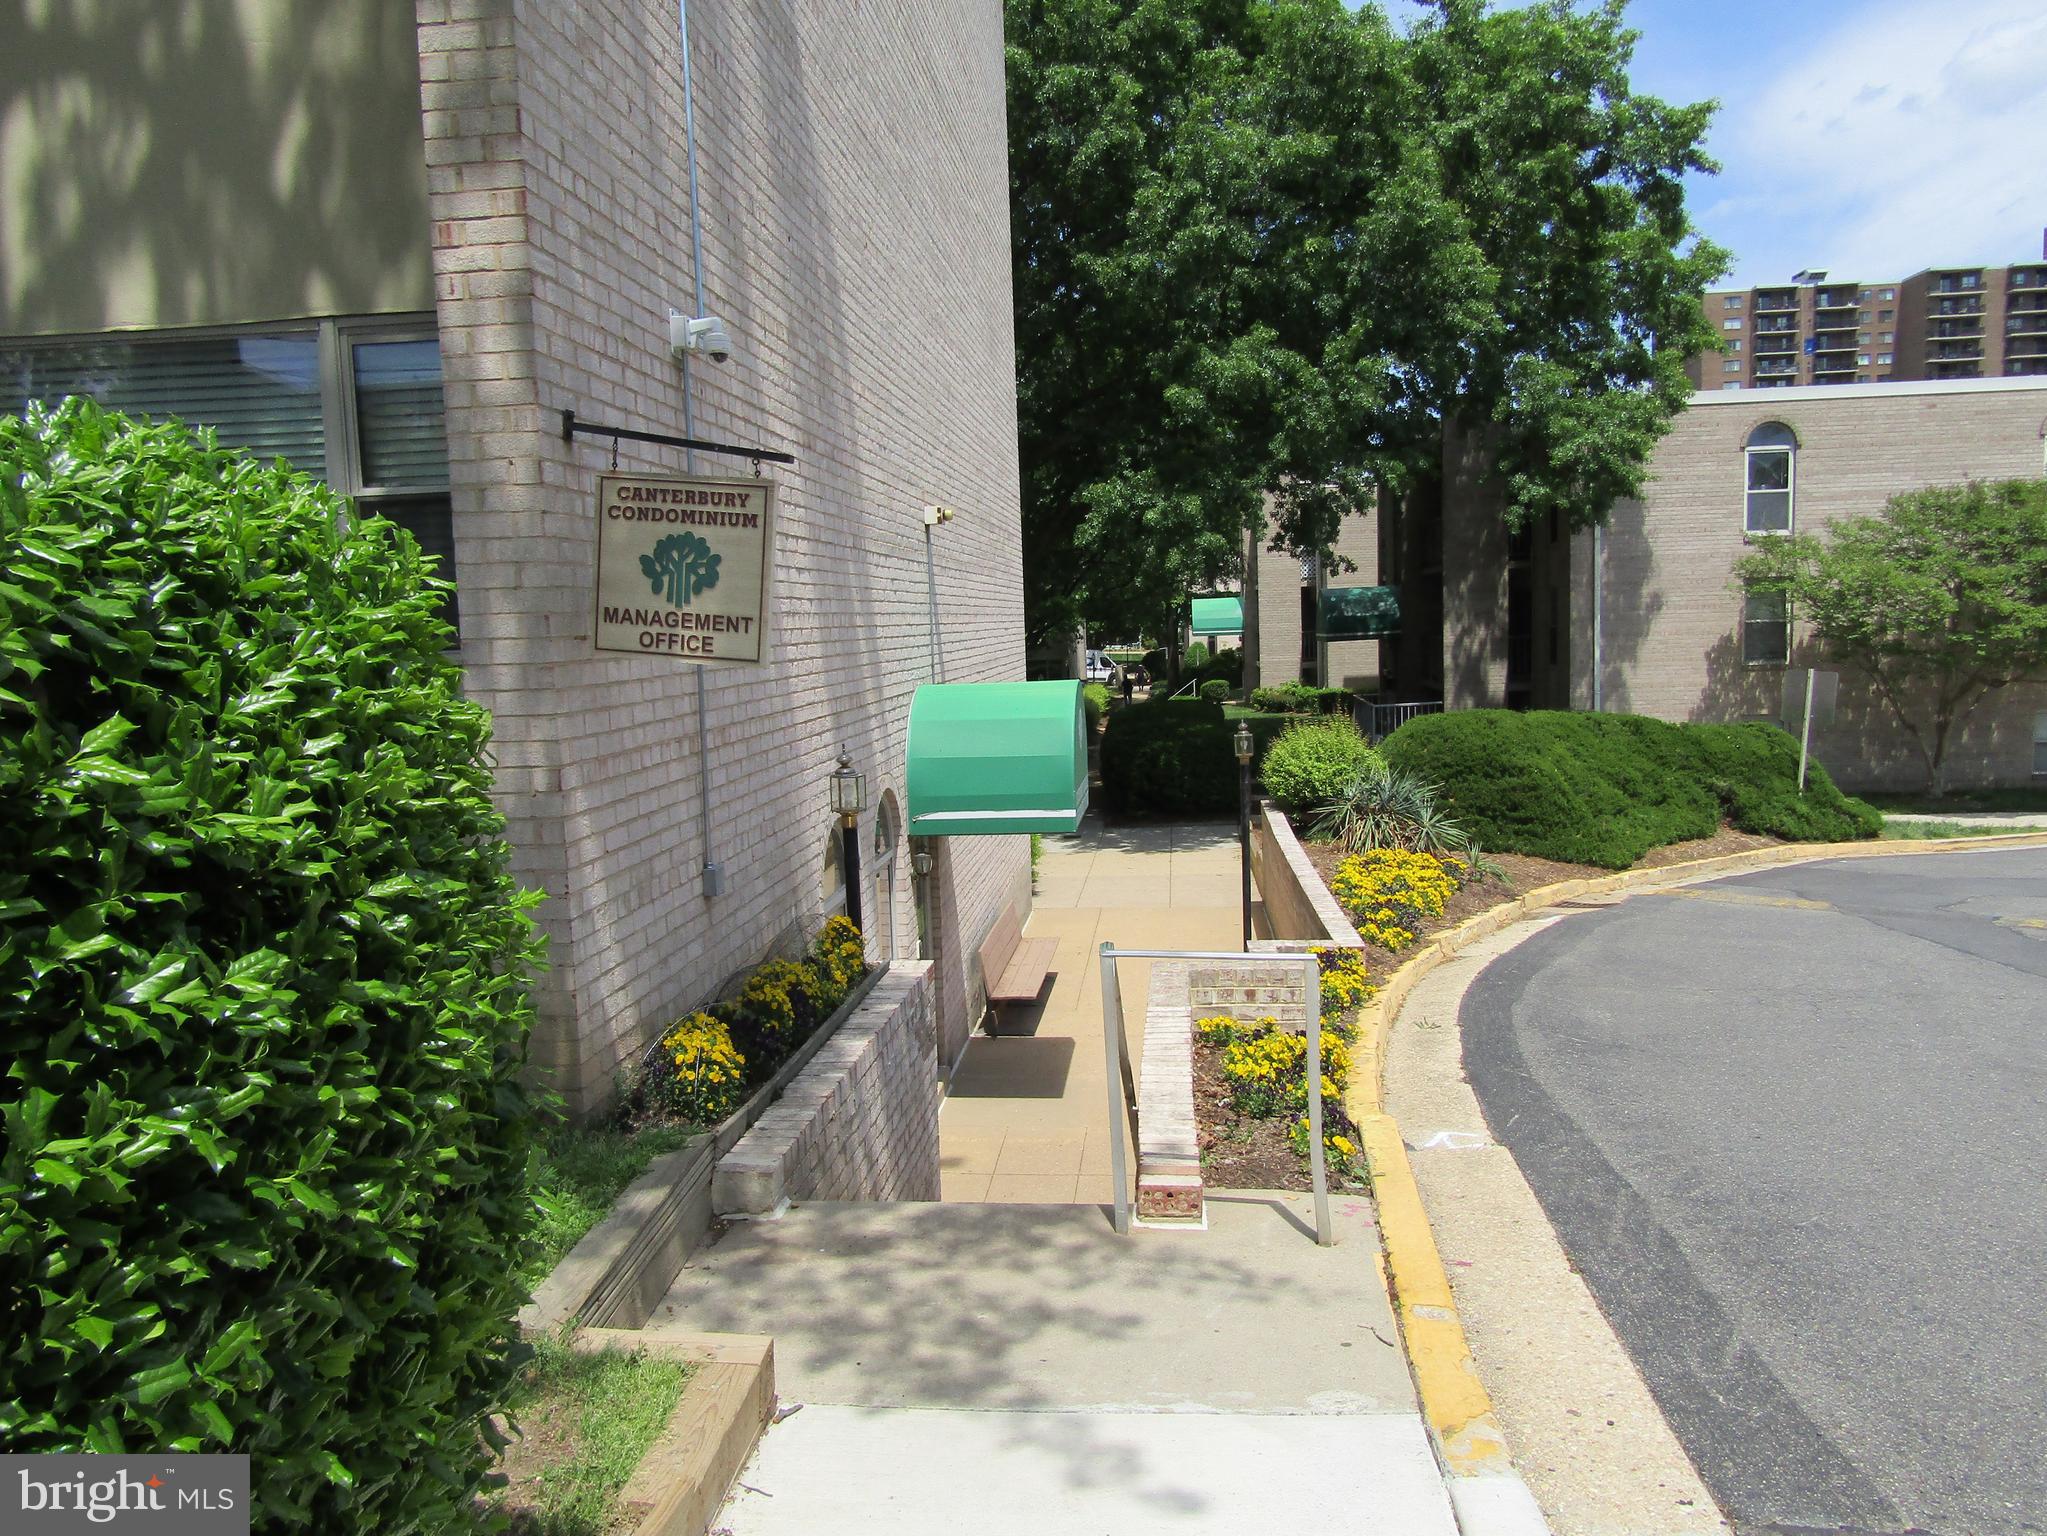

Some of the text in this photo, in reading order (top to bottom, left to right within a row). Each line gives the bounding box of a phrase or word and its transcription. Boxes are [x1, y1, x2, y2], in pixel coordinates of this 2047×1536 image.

[617, 486, 750, 507] CANTERBURY
[607, 505, 758, 528] CONDOMINIUM
[603, 607, 753, 634] MANAGEMENT
[639, 631, 714, 653] OFFICE
